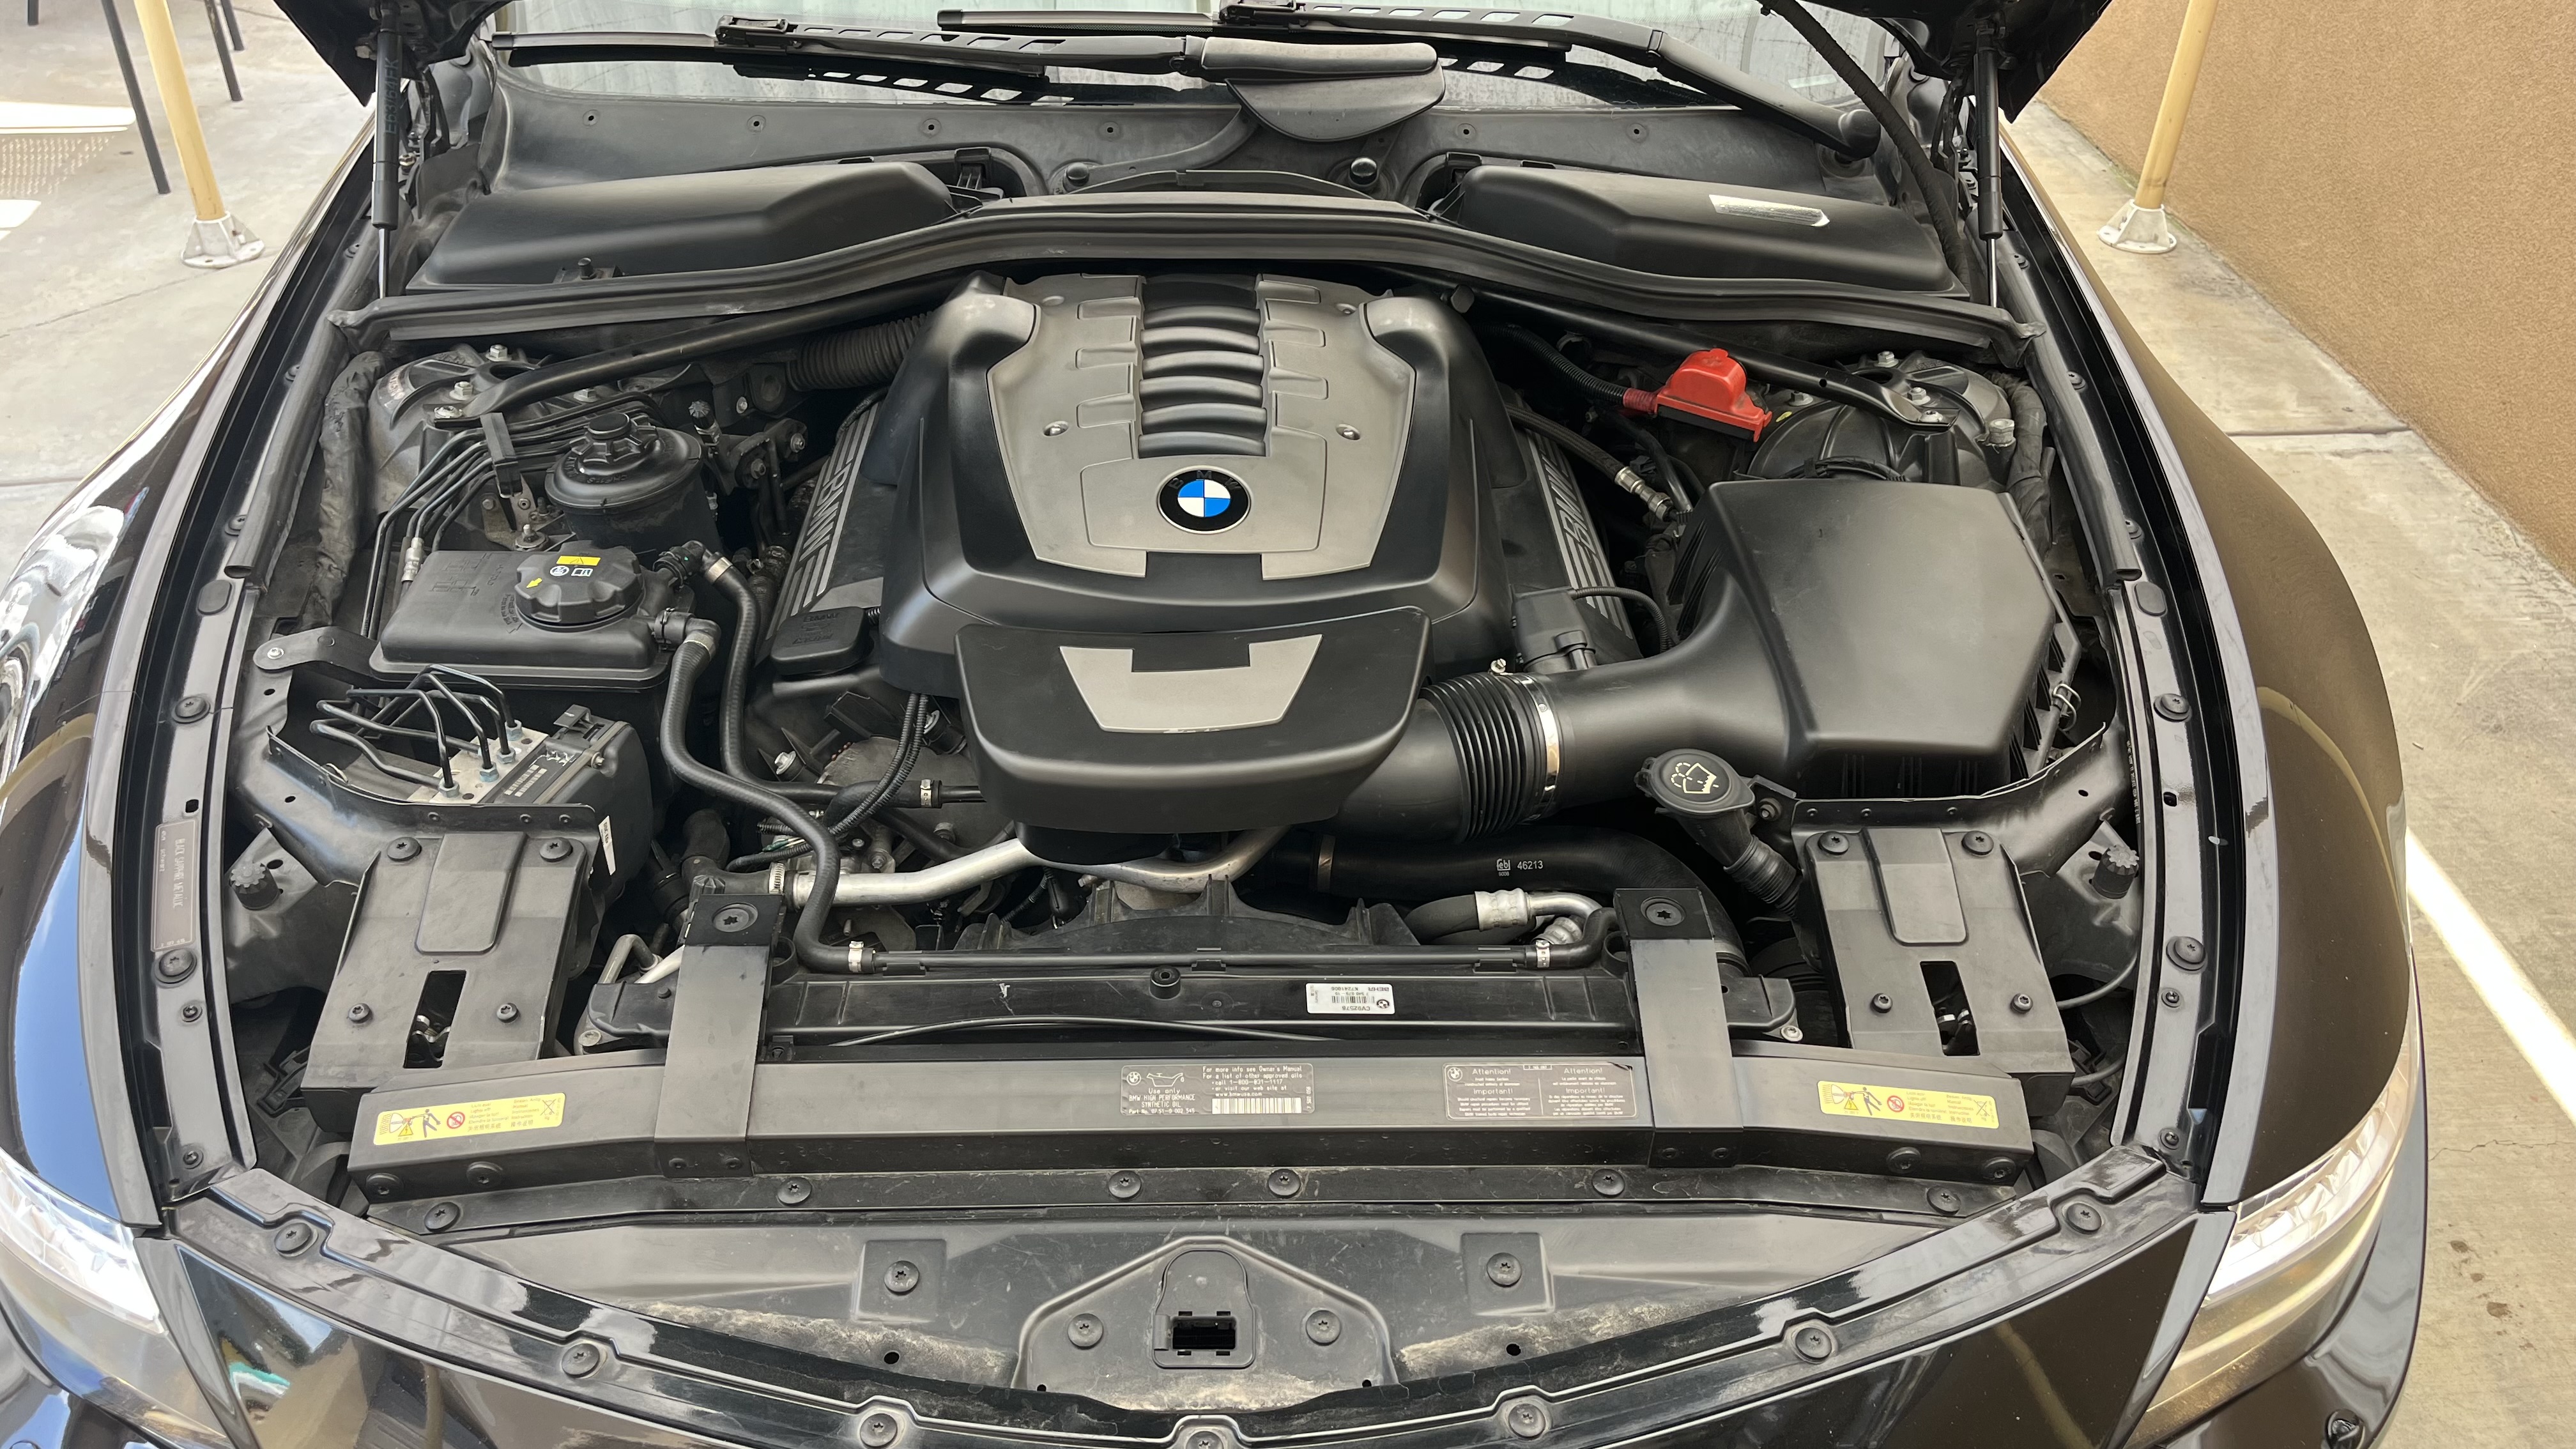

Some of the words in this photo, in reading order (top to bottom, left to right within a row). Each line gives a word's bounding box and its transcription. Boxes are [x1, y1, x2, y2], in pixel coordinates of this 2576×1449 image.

[1167, 470, 1242, 490] BMW
[799, 462, 852, 562] BMW
[1542, 456, 1597, 555] BMW
[174, 838, 185, 855] BLACK
[174, 856, 185, 881] SAPPHIRE
[1517, 860, 1544, 870] 46213
[172, 882, 184, 908] METALLIC
